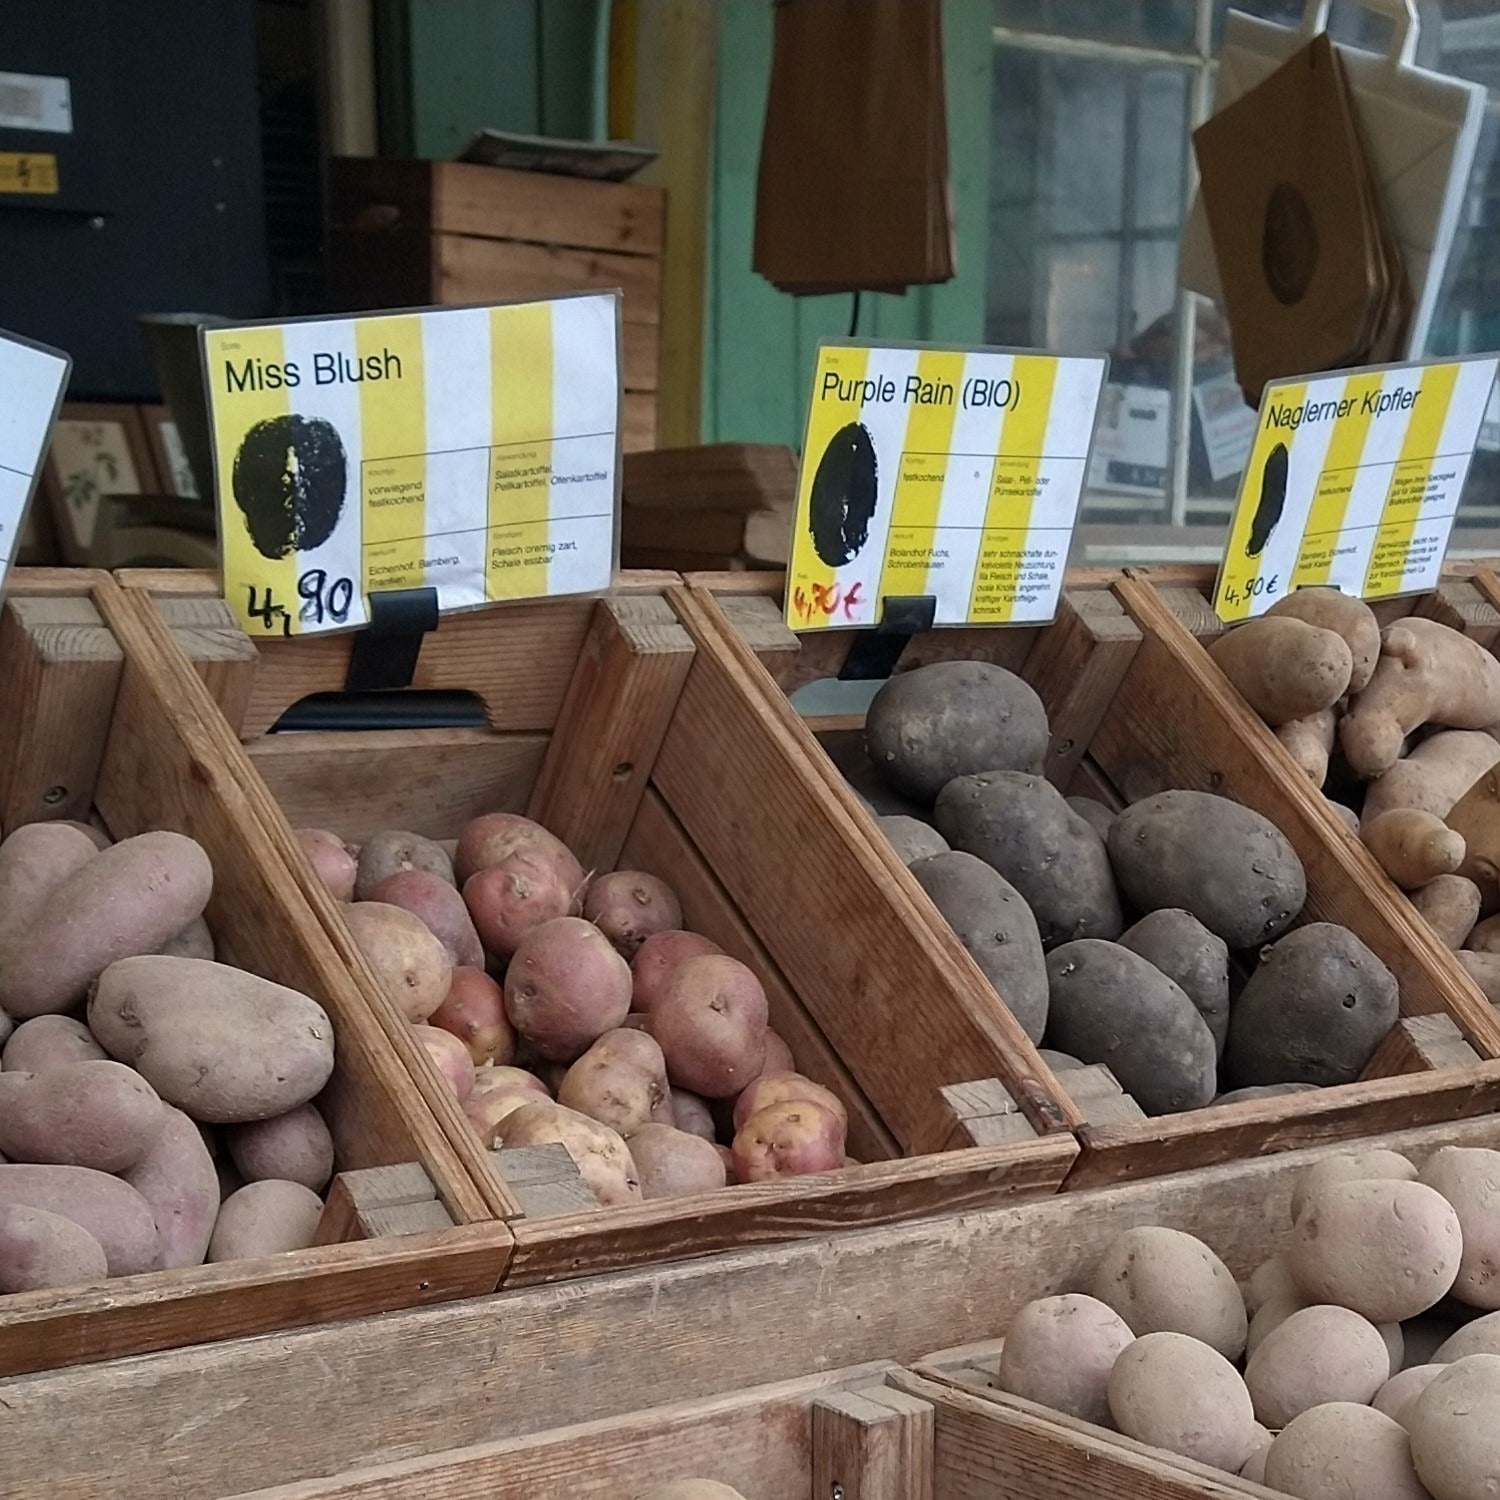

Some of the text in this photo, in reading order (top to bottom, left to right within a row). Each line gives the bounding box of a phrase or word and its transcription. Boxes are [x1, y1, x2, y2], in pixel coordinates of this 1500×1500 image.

[225, 347, 403, 393] Miss Blush
[821, 371, 1021, 412] Purple Rain (BIO)
[1265, 386, 1422, 431] Naglerner Kipfler
[550, 471, 608, 486] Ofenkartoffel
[903, 472, 945, 483] festkochend
[368, 492, 425, 508] festkochend
[492, 545, 523, 558] Fleisch
[558, 540, 578, 551] zart,
[418, 555, 461, 570] Bamberg,
